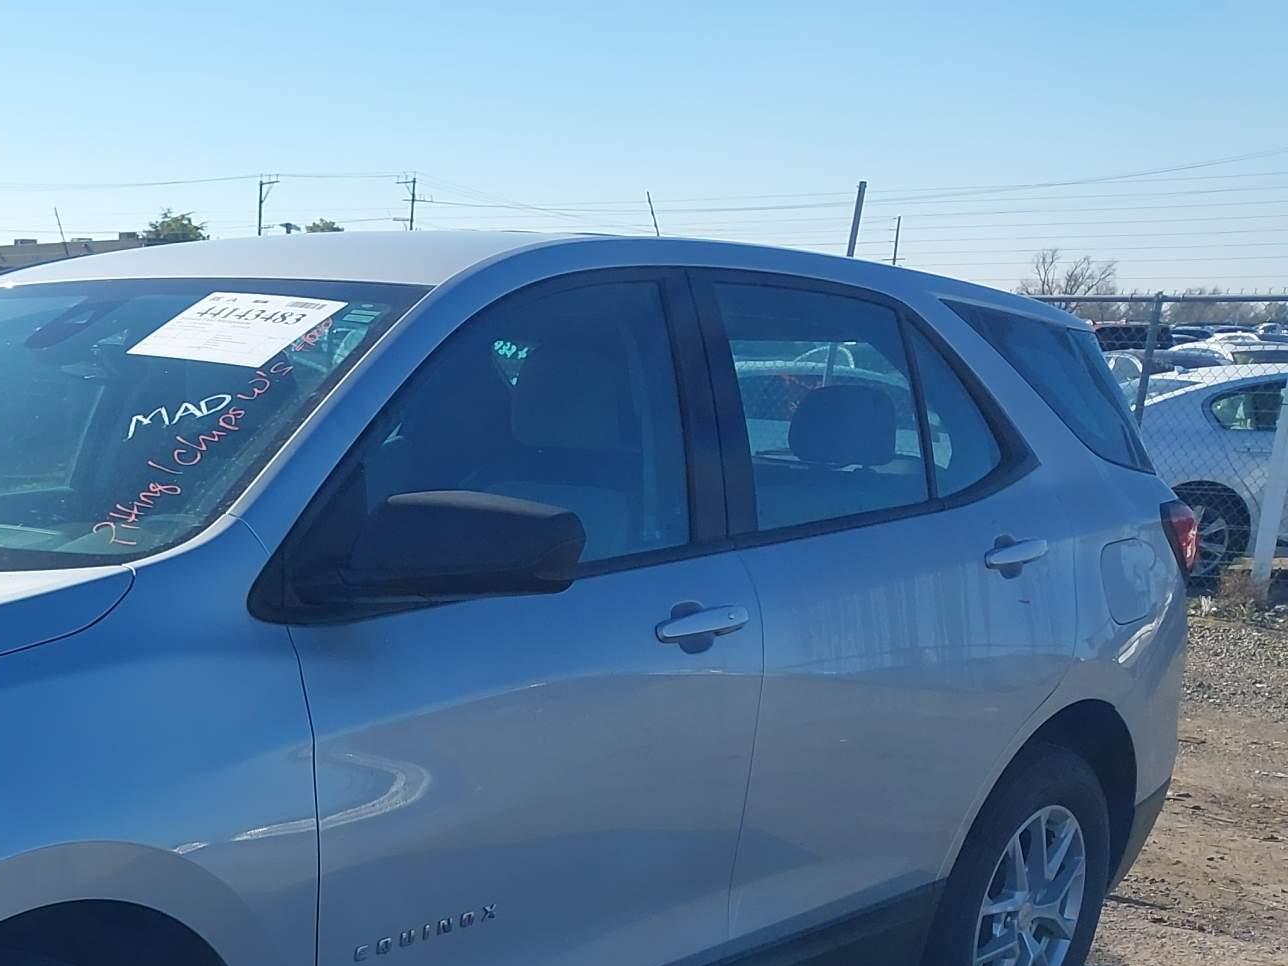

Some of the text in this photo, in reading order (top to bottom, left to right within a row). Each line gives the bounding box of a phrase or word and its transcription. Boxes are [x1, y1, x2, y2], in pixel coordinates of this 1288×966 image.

[196, 305, 308, 326] 44143483
[124, 394, 232, 441] MAD
[353, 904, 497, 962] EQUINOX
